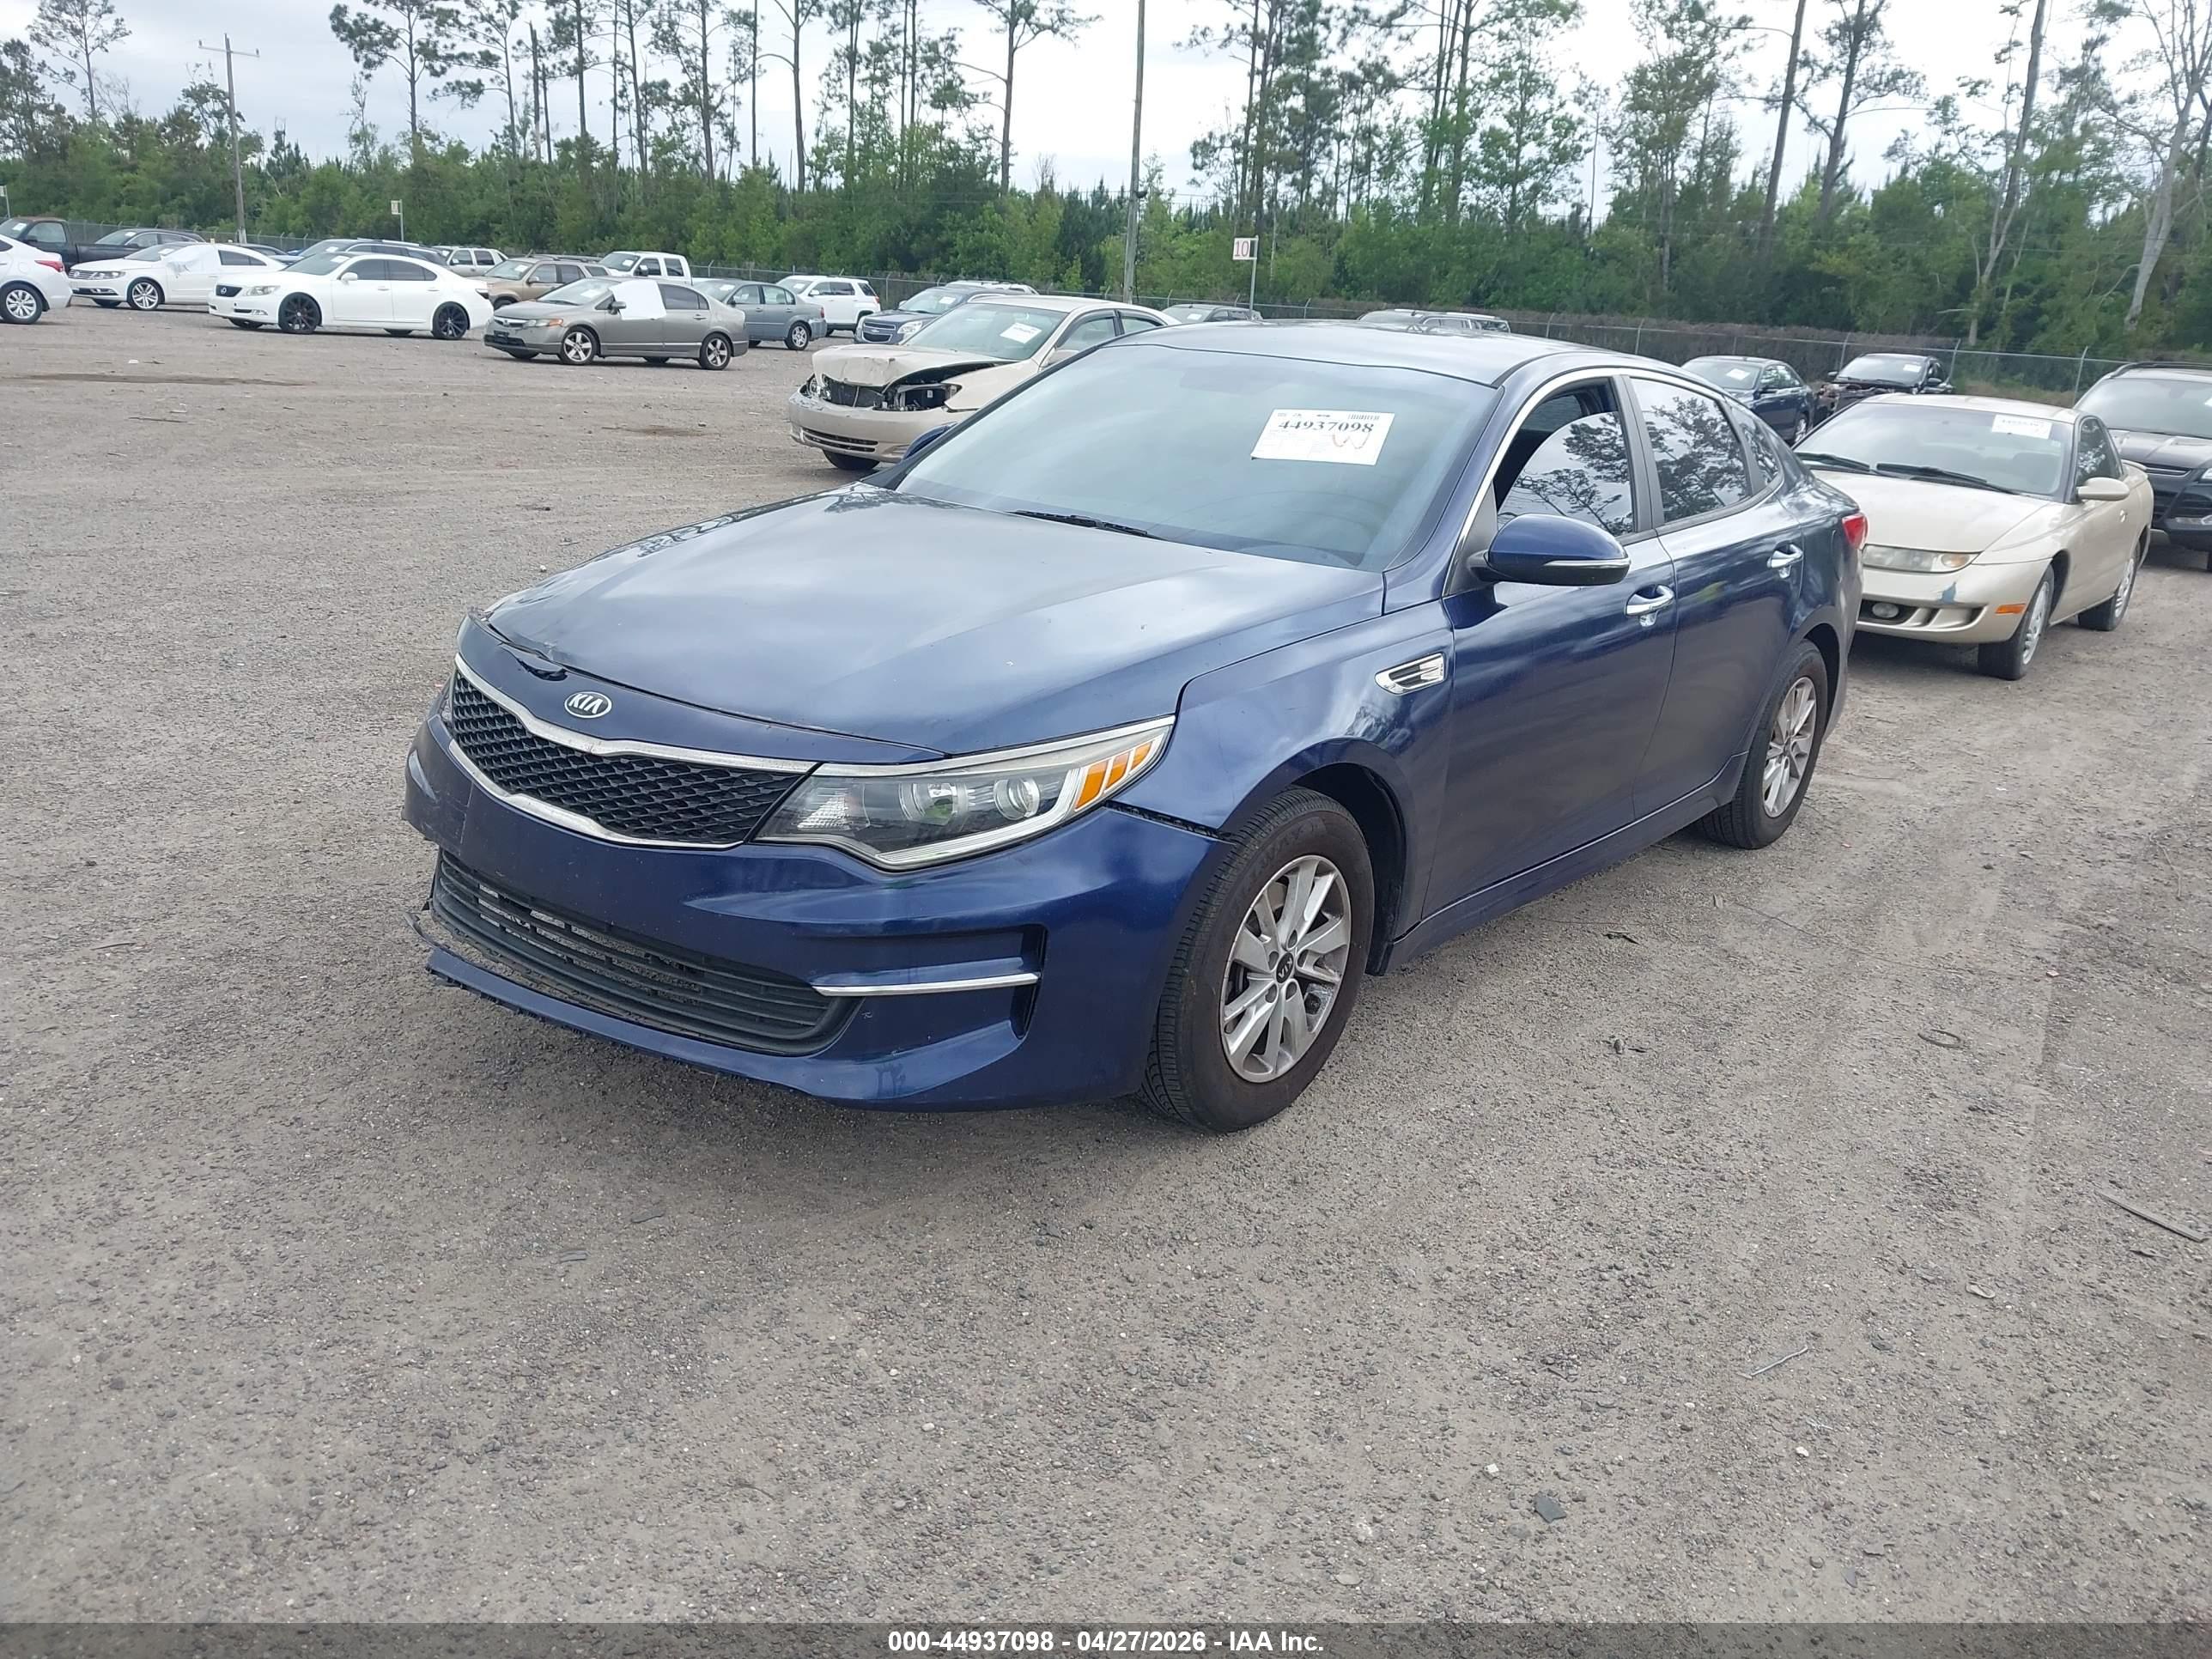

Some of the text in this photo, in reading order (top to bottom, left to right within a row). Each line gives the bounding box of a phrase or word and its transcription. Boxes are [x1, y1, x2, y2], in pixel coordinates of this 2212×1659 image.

[1234, 240, 1249, 257] 10
[1278, 419, 1375, 434] 44937098
[568, 692, 604, 714] KIA
[1278, 957, 1293, 979] KIA
